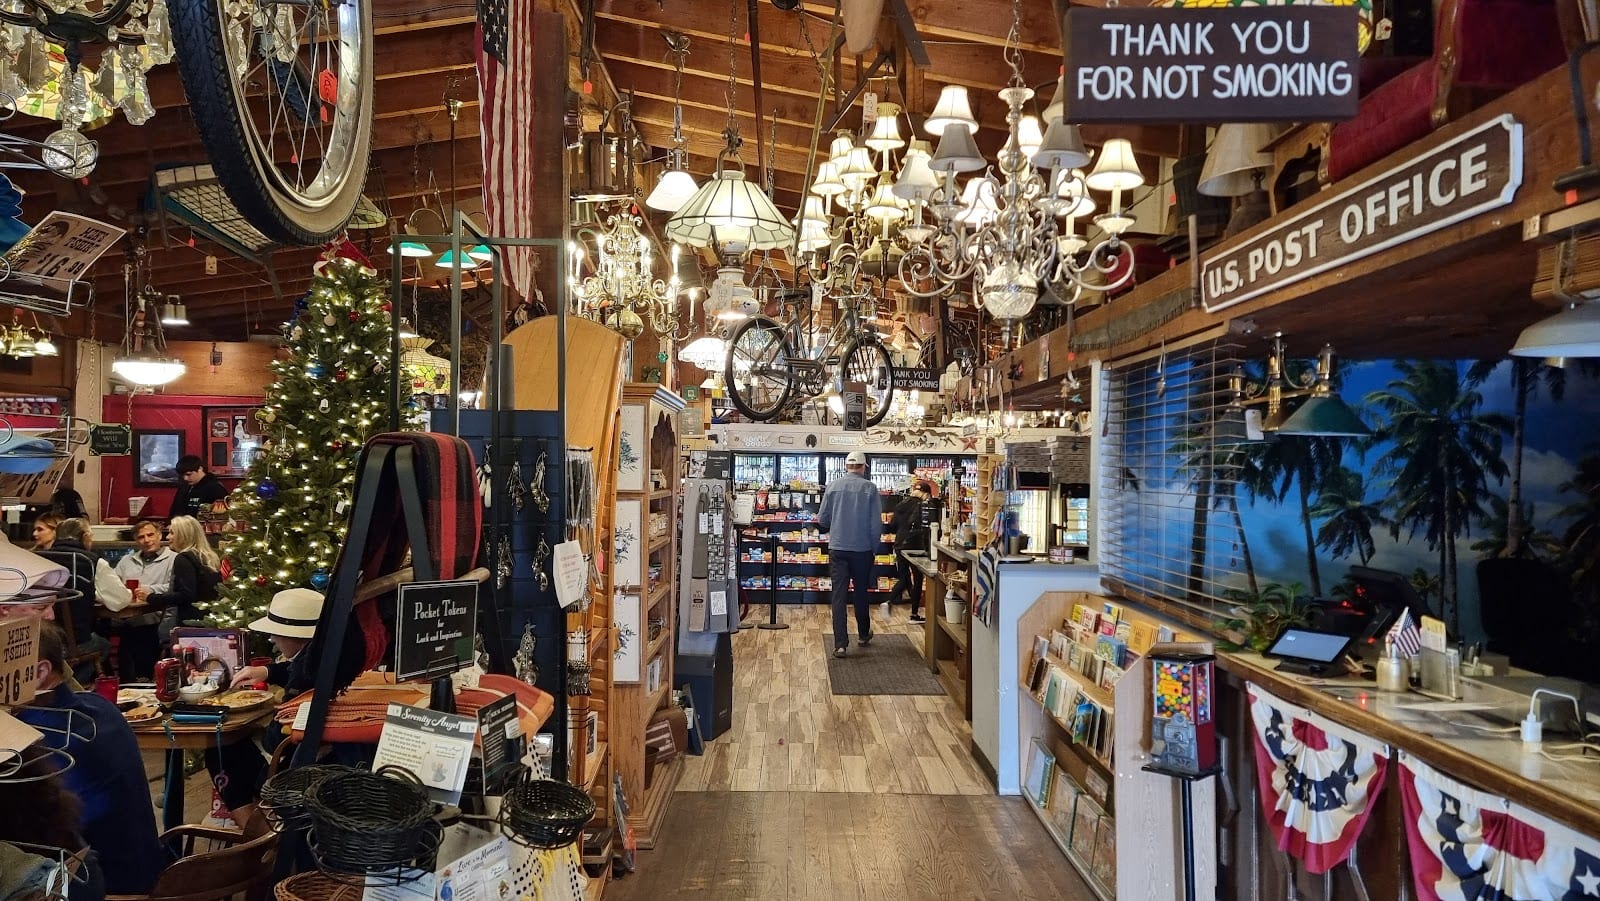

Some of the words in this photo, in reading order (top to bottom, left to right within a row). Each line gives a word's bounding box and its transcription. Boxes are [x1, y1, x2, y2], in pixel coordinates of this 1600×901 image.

[1101, 21, 1214, 57] THANK
[1231, 20, 1310, 55] YOU
[1077, 66, 1136, 100] FOR
[1142, 64, 1205, 99] NOT
[1212, 60, 1353, 98] SMOKING
[1207, 263, 1244, 299] U.S.
[1249, 219, 1324, 284] POST
[1339, 143, 1488, 244] OFFICE
[908, 380, 938, 389] SMOKING
[913, 371, 930, 380] YOU
[414, 601, 440, 620] Pocket
[442, 599, 467, 617] Tokens
[401, 707, 432, 727] Serenity
[431, 716, 461, 732] Angel
